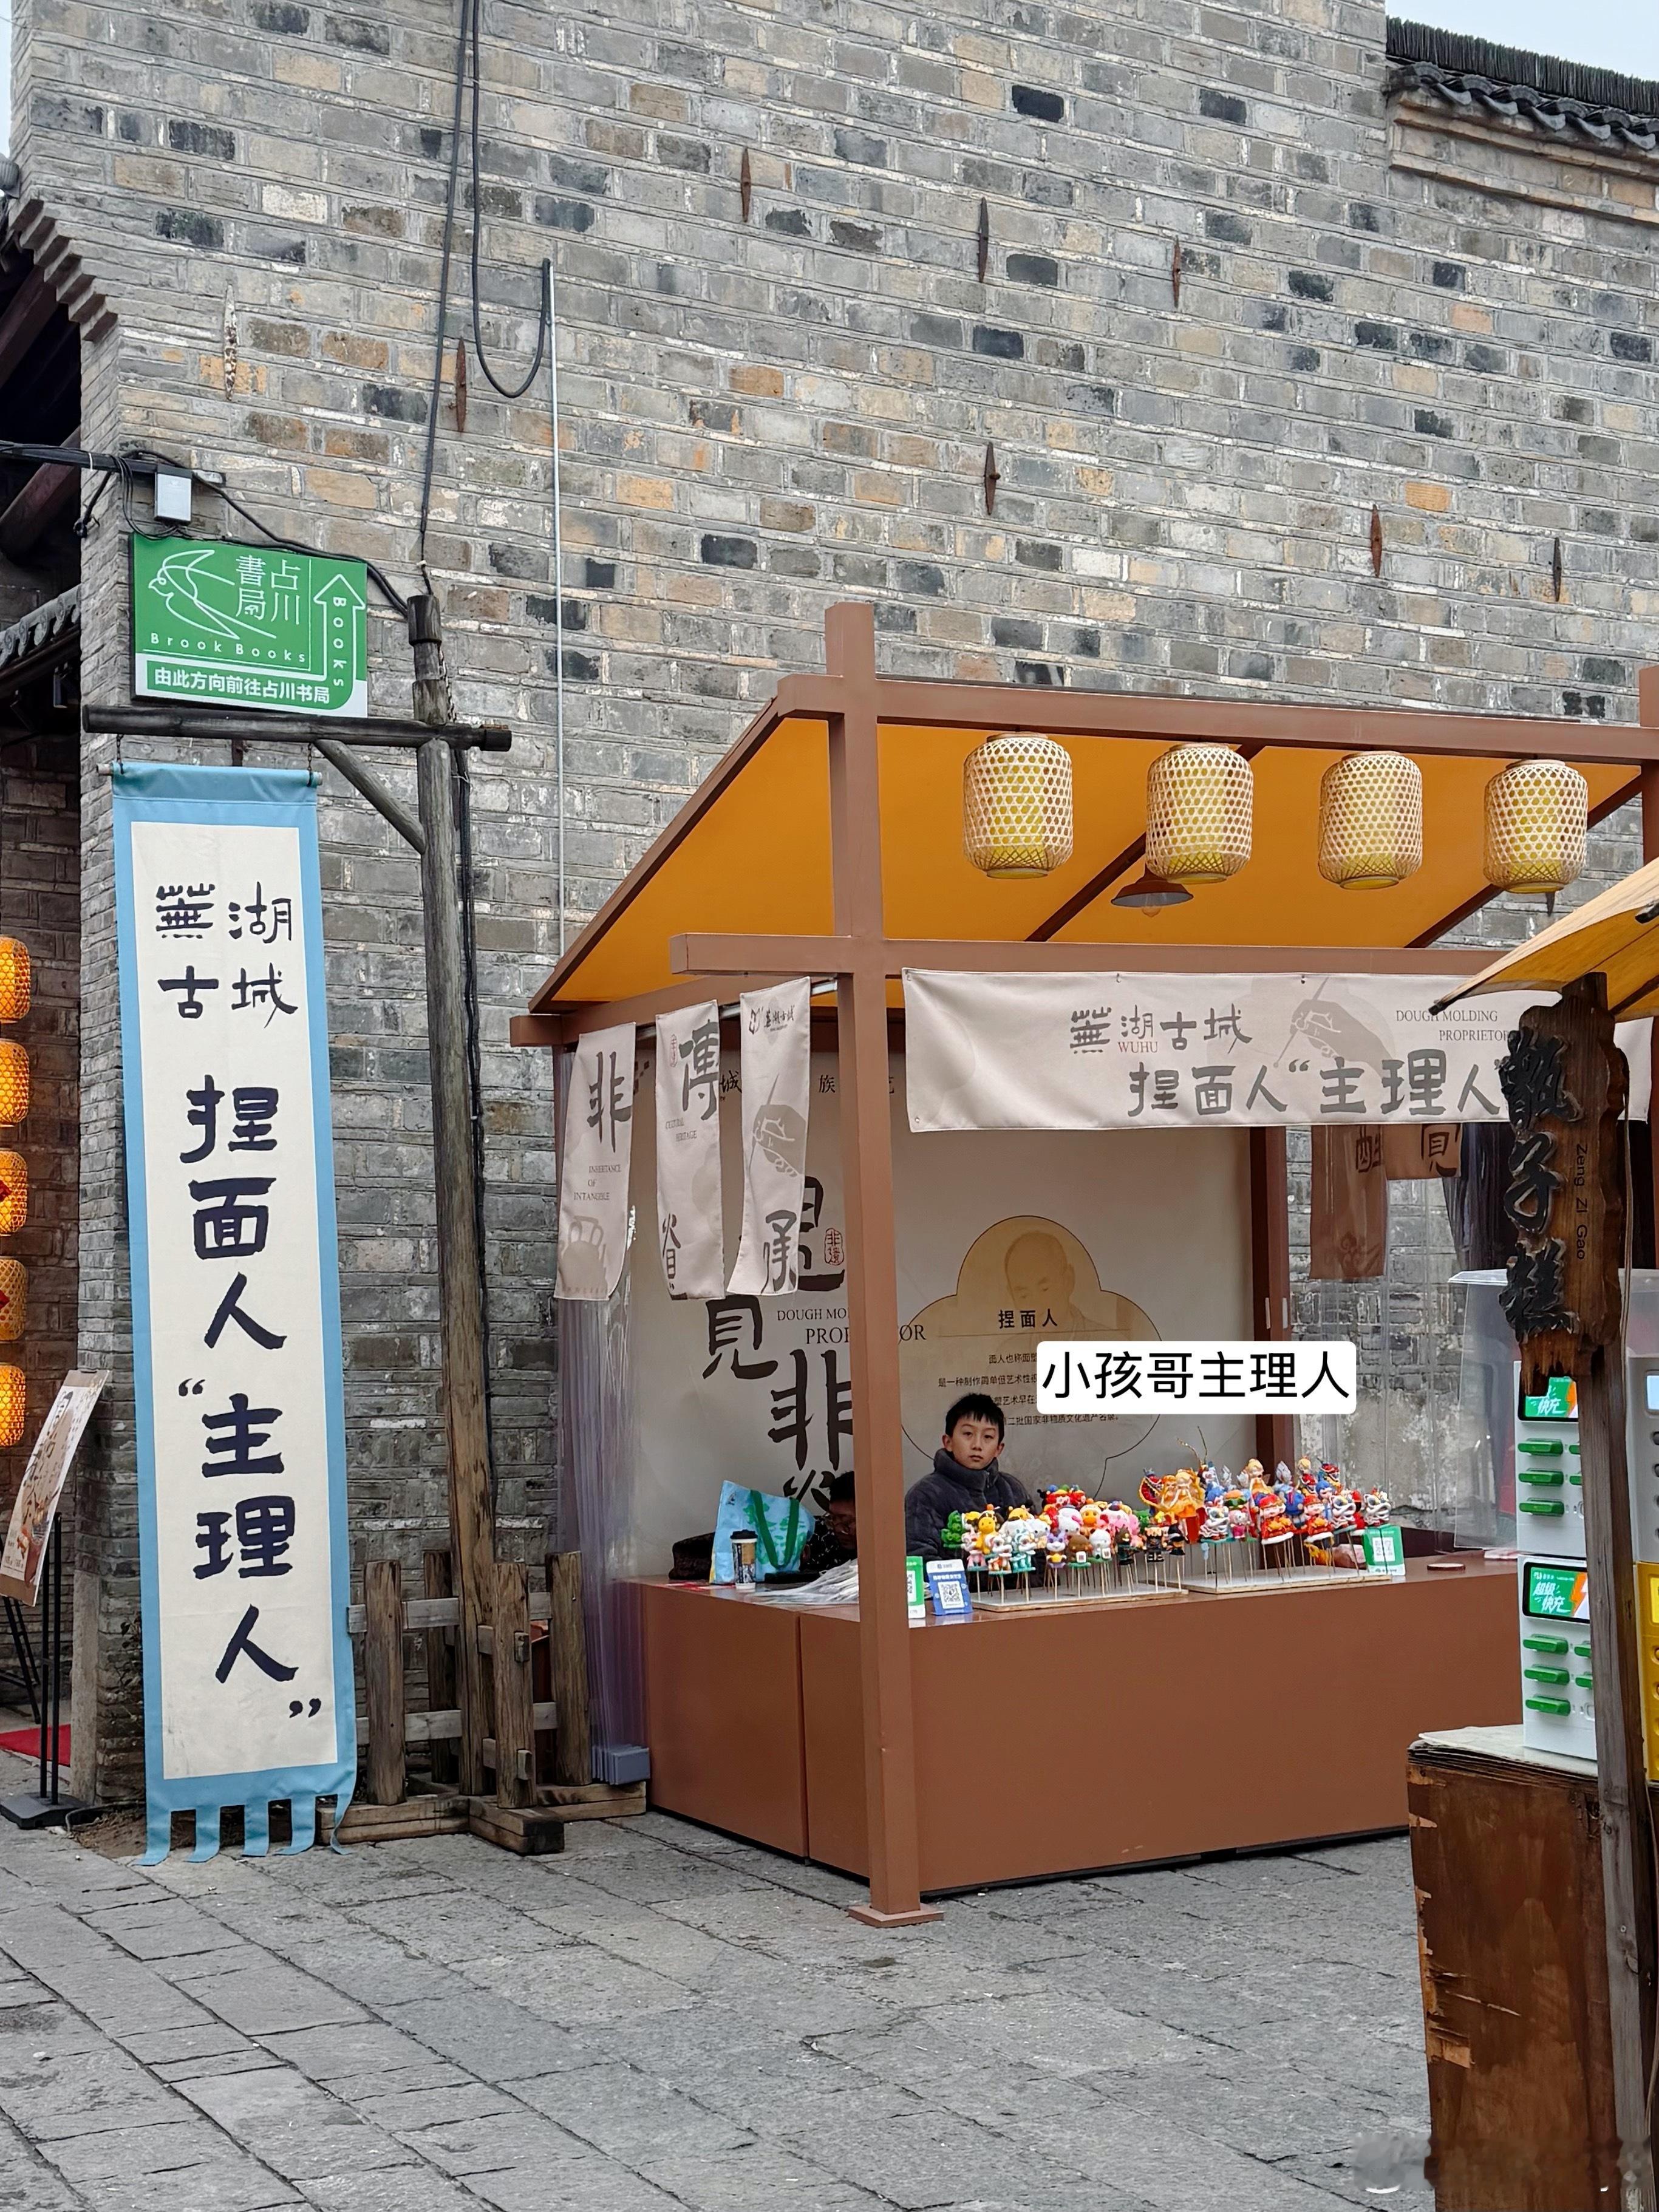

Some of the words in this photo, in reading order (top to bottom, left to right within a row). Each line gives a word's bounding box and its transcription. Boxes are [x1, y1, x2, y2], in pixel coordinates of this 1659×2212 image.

[151, 633, 222, 653] Brook
[236, 644, 305, 663] Books
[333, 597, 347, 687] Books
[154, 667, 330, 704] 由此方向前往占川书局
[1443, 1010, 1497, 1021] MOLDING
[1118, 1041, 1158, 1053] WUHU
[1575, 1143, 1588, 1186] Zeng
[1576, 1223, 1588, 1260] Gao
[777, 1309, 822, 1321] DOUGH
[998, 1308, 1058, 1329] 捏面人
